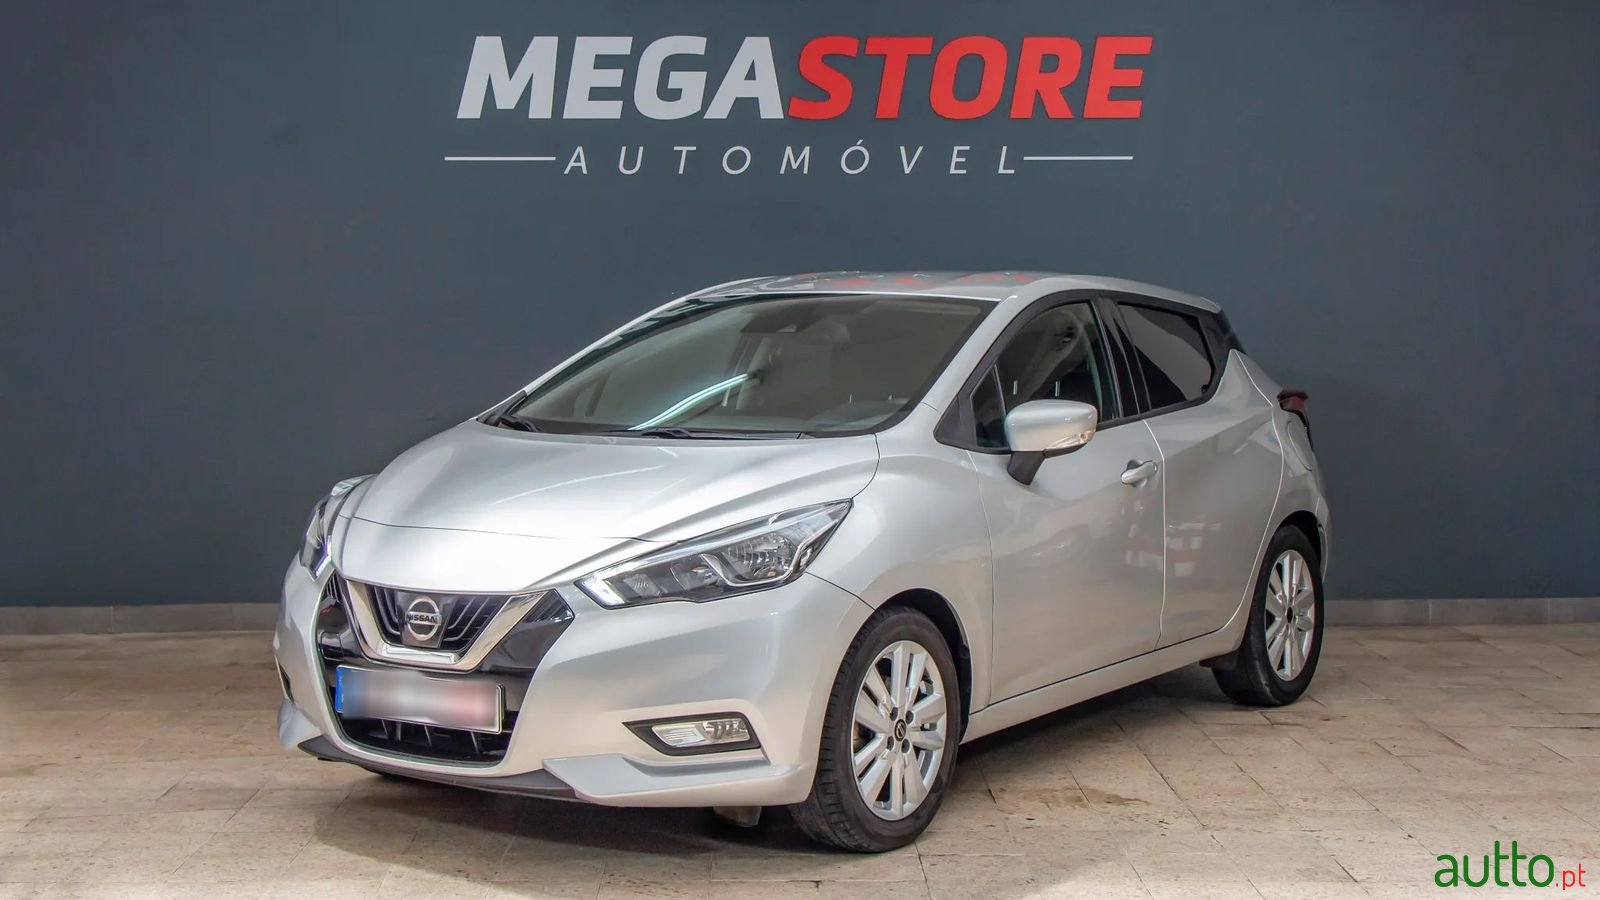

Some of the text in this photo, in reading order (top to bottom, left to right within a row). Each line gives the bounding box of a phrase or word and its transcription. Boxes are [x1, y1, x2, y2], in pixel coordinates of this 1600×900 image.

[456, 35, 1154, 120] MEGASTORE
[564, 139, 1015, 175] AUTOMÓVEL
[407, 613, 439, 624] NISSAN
